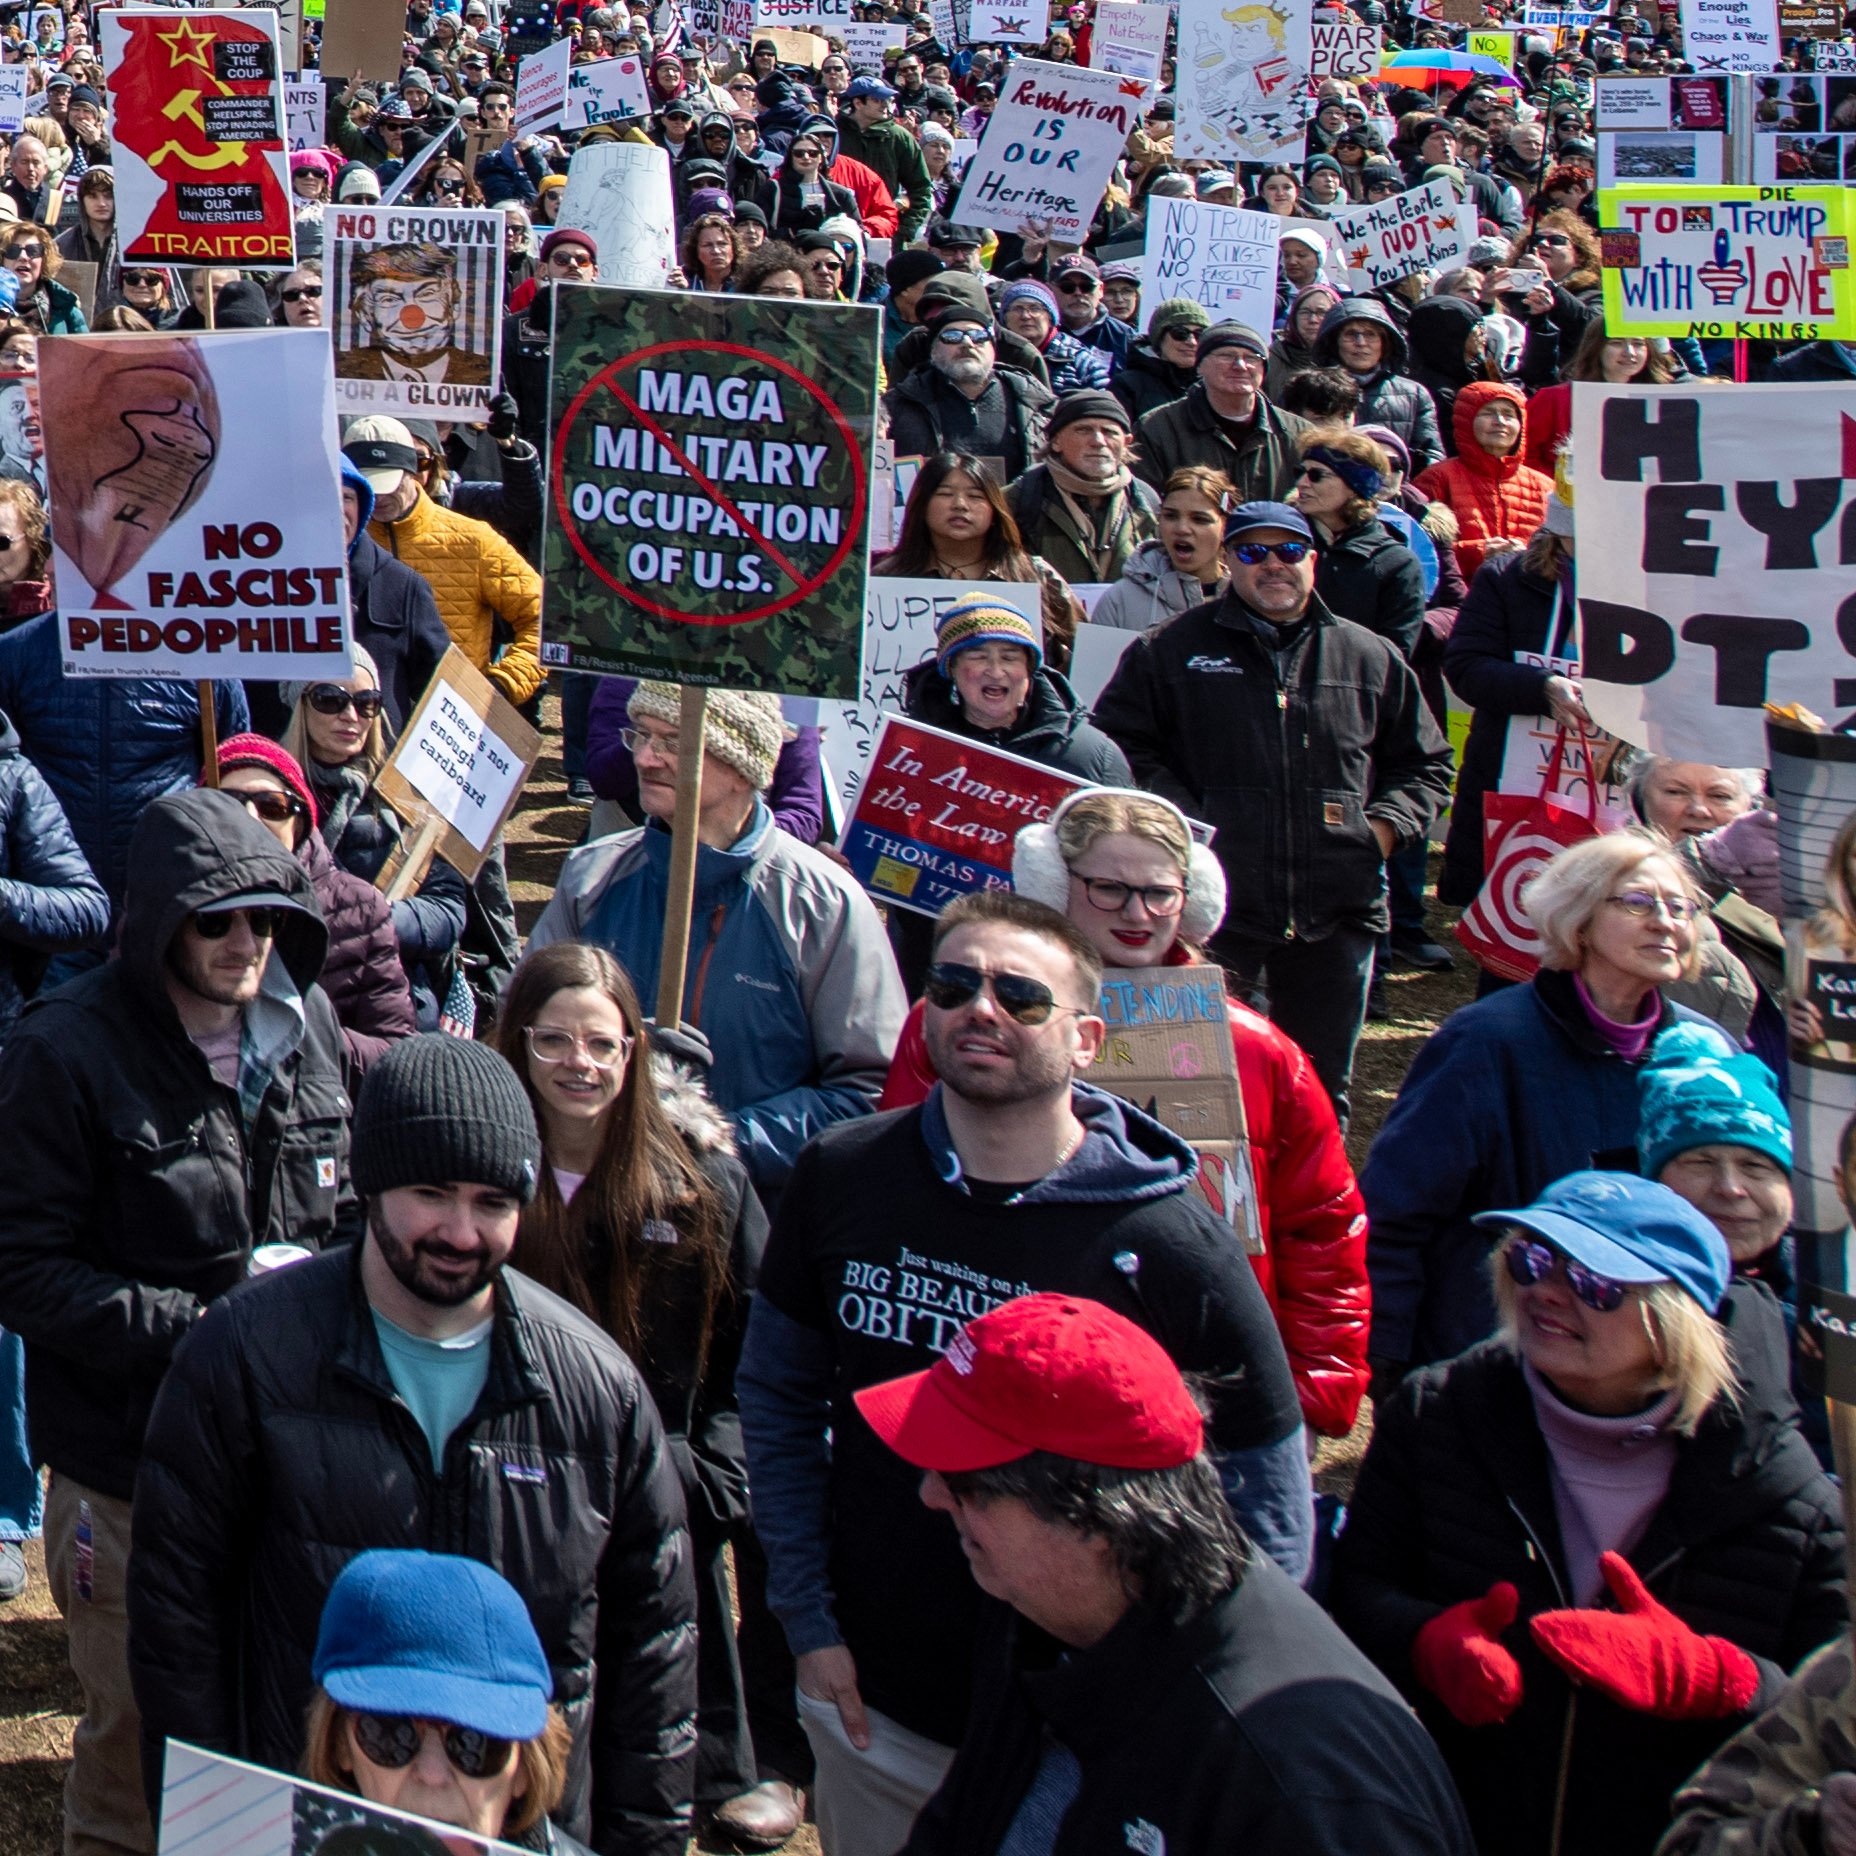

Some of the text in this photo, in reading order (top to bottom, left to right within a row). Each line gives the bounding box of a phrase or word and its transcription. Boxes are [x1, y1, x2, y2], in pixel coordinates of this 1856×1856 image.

[1698, 2, 1748, 12] Enough
[226, 44, 260, 53] STOP
[1312, 26, 1376, 48] WAR
[227, 68, 263, 78] COUP
[233, 56, 257, 66] THE
[1312, 51, 1371, 74] PIGS
[1732, 64, 1770, 72] KINGS
[1033, 119, 1066, 141] IS
[1003, 143, 1080, 173] OUR
[203, 199, 232, 209] OUR
[977, 170, 1079, 213] Heritage
[337, 214, 497, 243] NO CROWN
[1165, 202, 1280, 237] NO TRUMP
[1335, 194, 1442, 242] We the People
[1626, 202, 1826, 246] TO TRUMP
[146, 233, 294, 256] TRAITOR
[1163, 236, 1268, 264] NO KINGS
[1382, 216, 1430, 258] NOT
[1367, 242, 1458, 284] You the King
[1620, 246, 1835, 315] WITH LOVE
[1689, 320, 1818, 339] NO KINGS
[637, 369, 784, 424] MAGA
[593, 426, 827, 487] MILITARY
[572, 483, 840, 545] OCCUPATION
[203, 521, 283, 560] NO
[628, 543, 774, 593] OF U.S.
[148, 567, 343, 608] FASCIST
[68, 616, 343, 653] PEDOPHILE
[430, 720, 476, 771] enough
[440, 697, 510, 775] There's not
[420, 738, 487, 809] cardboard
[870, 785, 1007, 845] the Law
[844, 1260, 891, 1292] BIG
